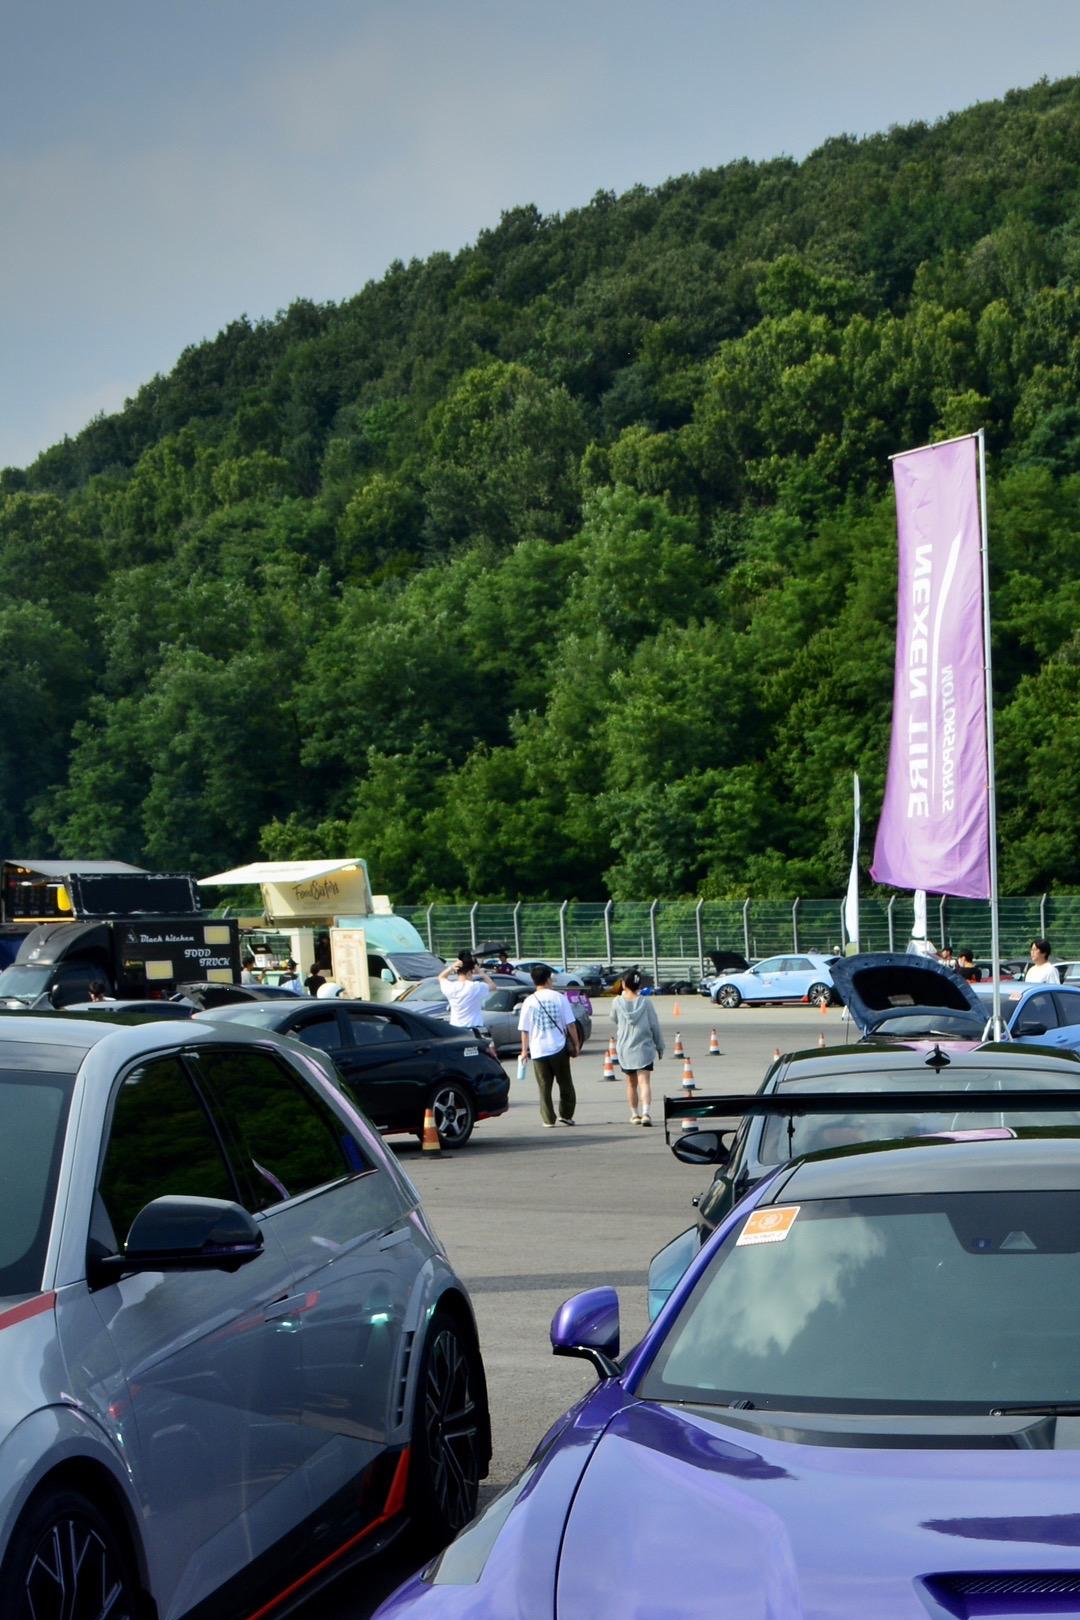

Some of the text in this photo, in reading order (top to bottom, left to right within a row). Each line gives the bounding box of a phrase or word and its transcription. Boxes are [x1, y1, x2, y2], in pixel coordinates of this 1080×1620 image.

[140, 934, 195, 943] Black kitchen
[184, 949, 211, 958] FOOD
[199, 957, 231, 967] TRUCK
